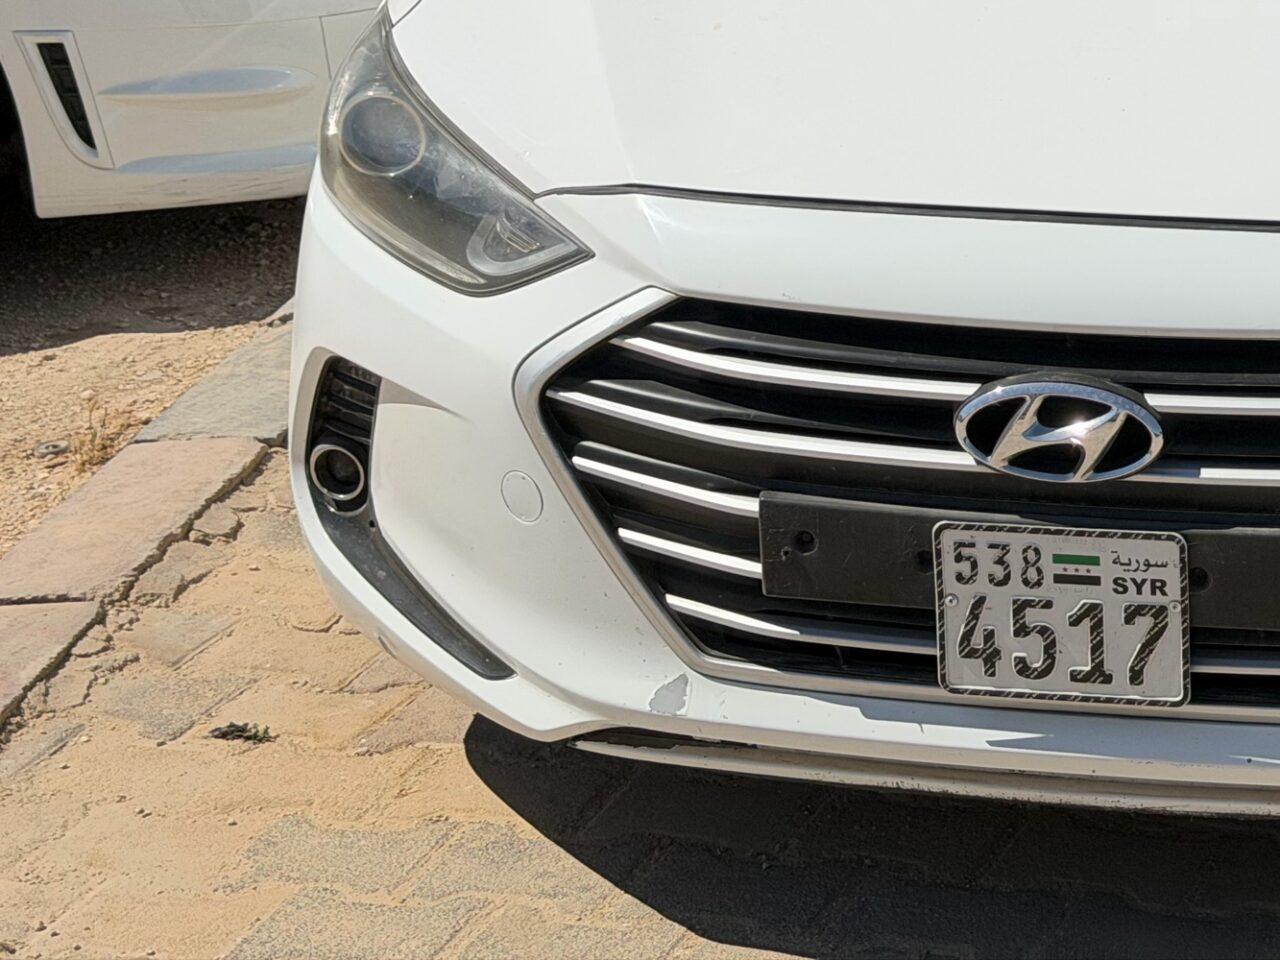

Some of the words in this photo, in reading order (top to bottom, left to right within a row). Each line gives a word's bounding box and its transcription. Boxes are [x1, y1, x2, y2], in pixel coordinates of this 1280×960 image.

[953, 541, 1045, 590] 538
[1110, 549, 1169, 573] سورية
[1111, 576, 1169, 597] SYR
[957, 594, 1170, 687] 4517
